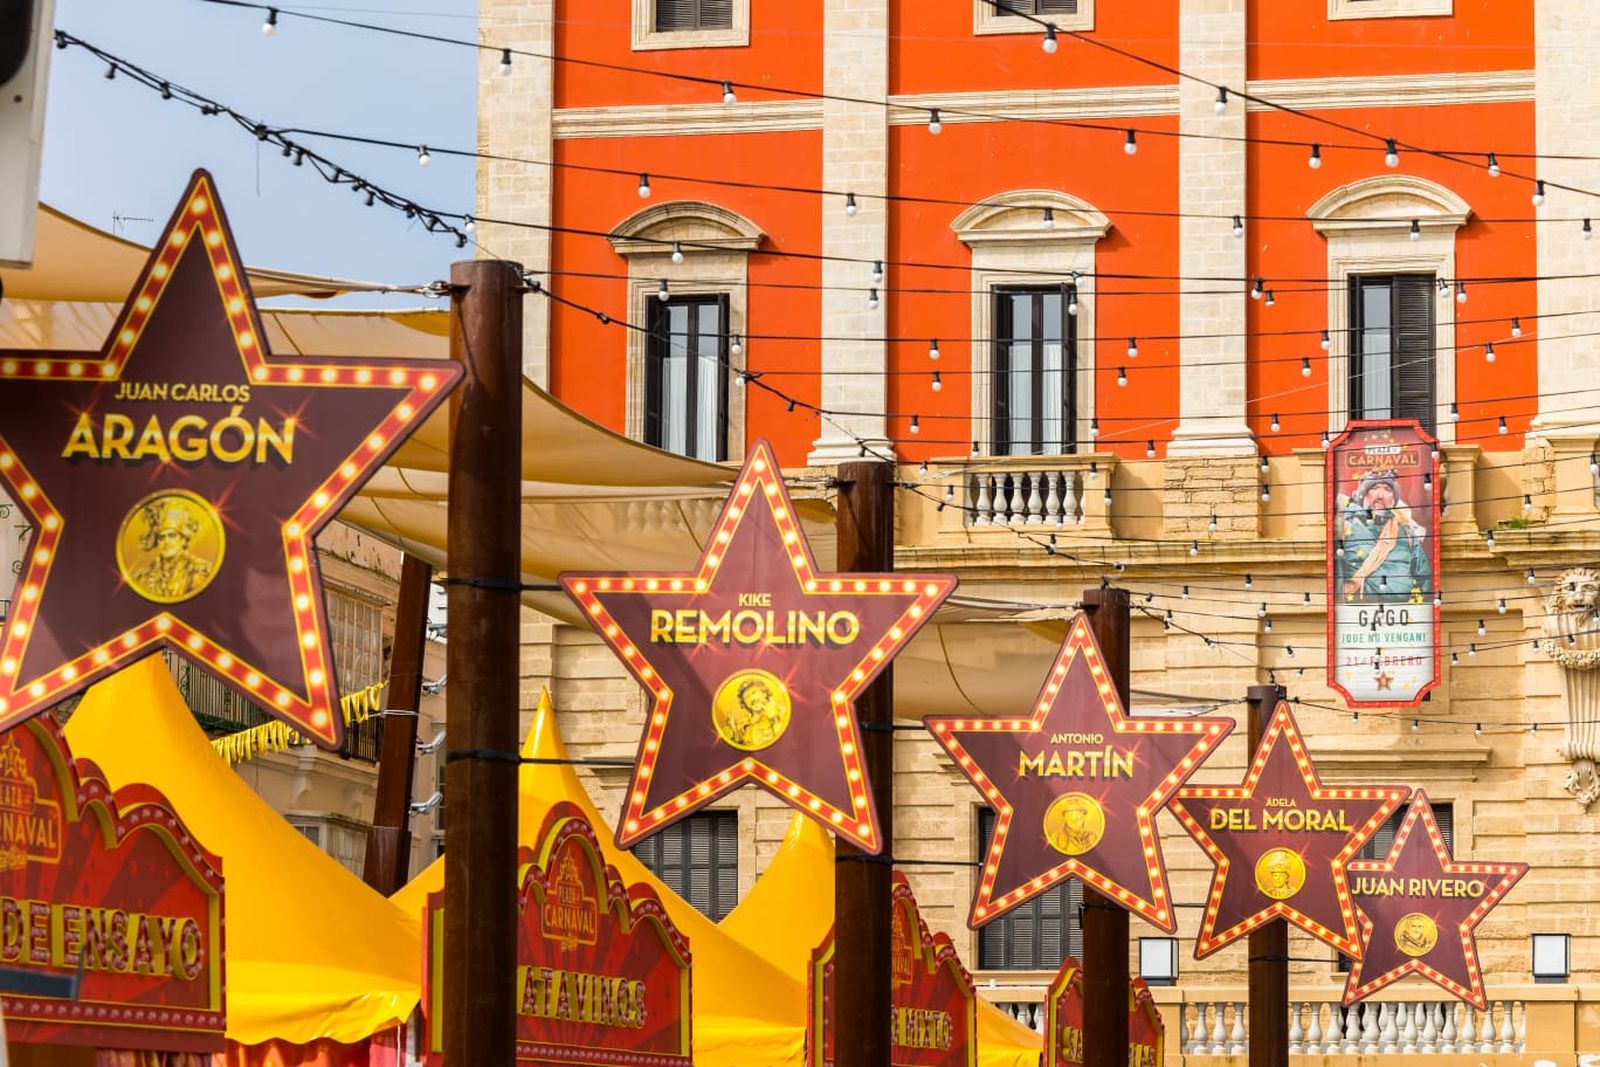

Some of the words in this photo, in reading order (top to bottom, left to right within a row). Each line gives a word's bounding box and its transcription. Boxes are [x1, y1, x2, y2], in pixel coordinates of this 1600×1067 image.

[115, 382, 168, 401] JUAN
[171, 384, 251, 403] CARLOS
[61, 405, 296, 465] ARAGÓN
[1349, 454, 1417, 466] CARNAVAL
[739, 593, 772, 607] KIKE
[650, 609, 860, 645] REMOLINO
[1358, 609, 1409, 627] GAGO
[1370, 656, 1423, 667] FBRERO
[1050, 733, 1104, 744] ANTONIO
[1019, 745, 1134, 778] MARTÍN
[1266, 798, 1297, 807] ADELA
[1210, 808, 1257, 831] DEL
[1262, 808, 1353, 832] MORAL
[1351, 877, 1404, 896] JUAN
[1408, 879, 1485, 898] RIVERO
[544, 904, 595, 935] CARNAVAL
[0, 897, 50, 965] DE
[54, 903, 204, 980] ENSAYO
